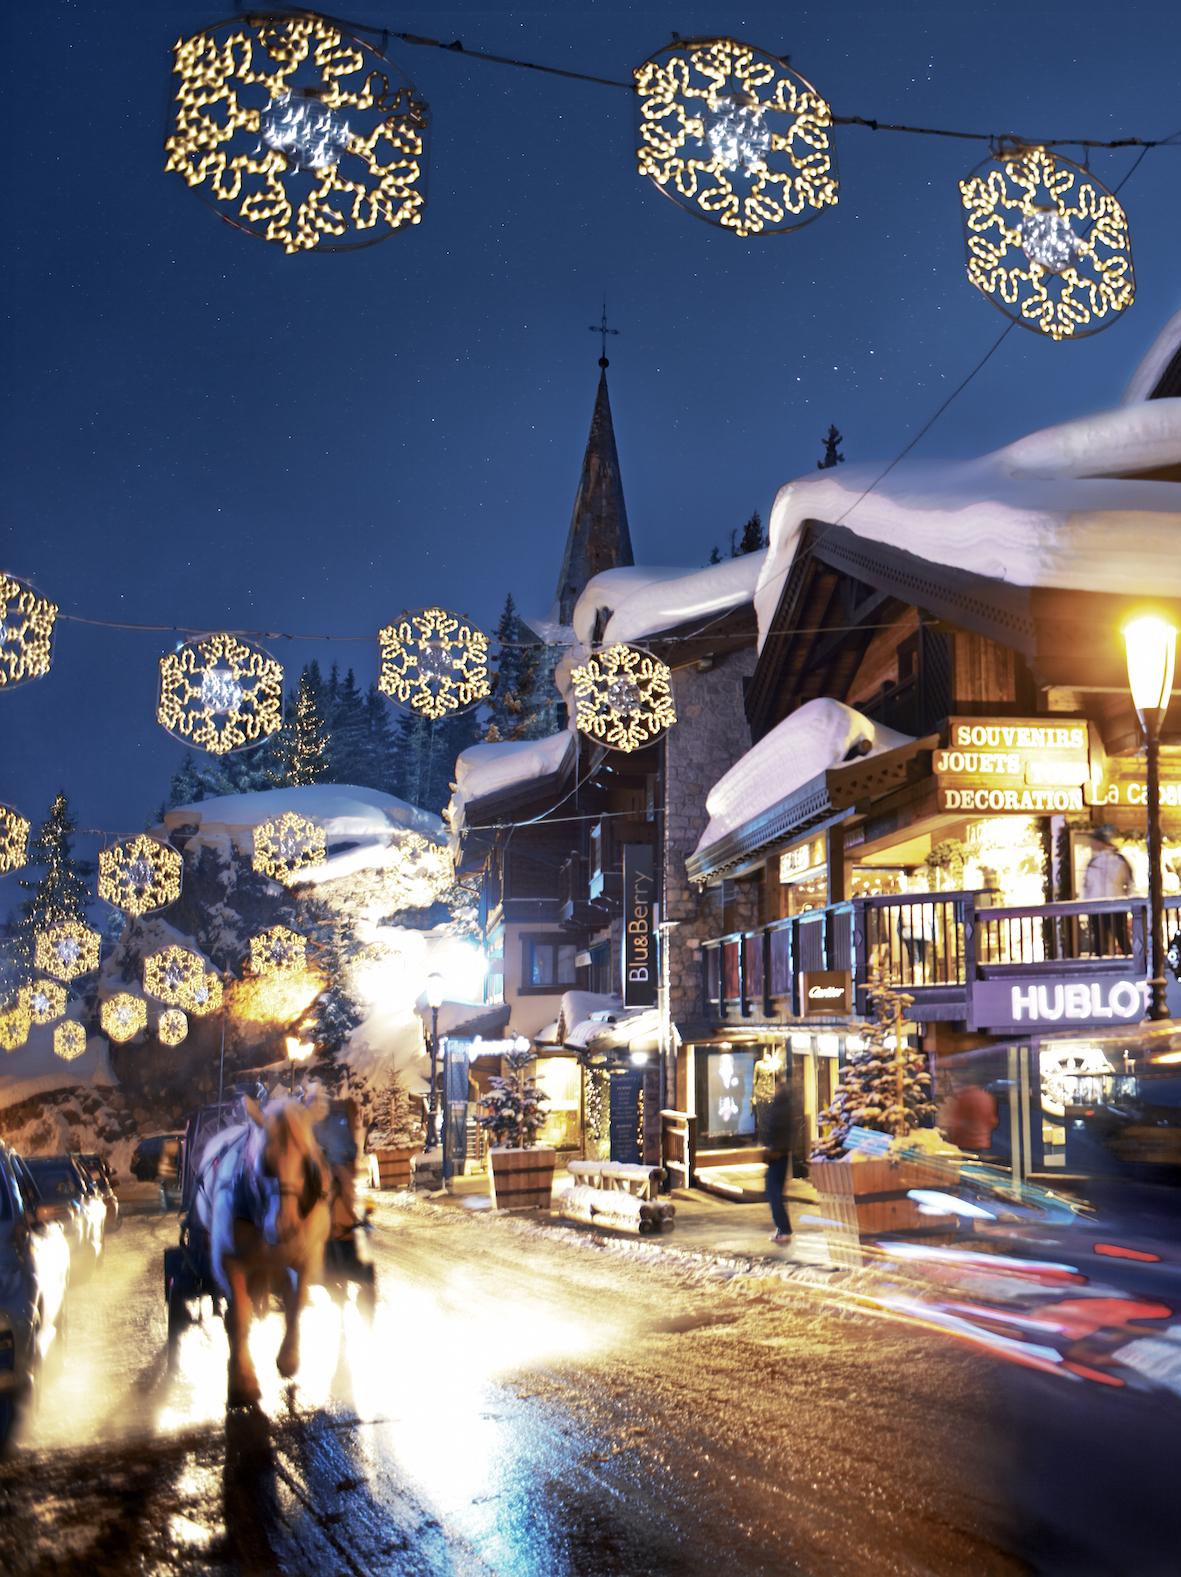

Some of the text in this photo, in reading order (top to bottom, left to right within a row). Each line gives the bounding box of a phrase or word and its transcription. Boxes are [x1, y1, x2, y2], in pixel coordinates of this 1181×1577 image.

[957, 726, 1084, 747] SOUVENIRS
[937, 752, 1020, 773] JOUETS
[944, 789, 1083, 811] DECORATION
[1091, 776, 1119, 806] La
[628, 870, 653, 981] Blu&Berry
